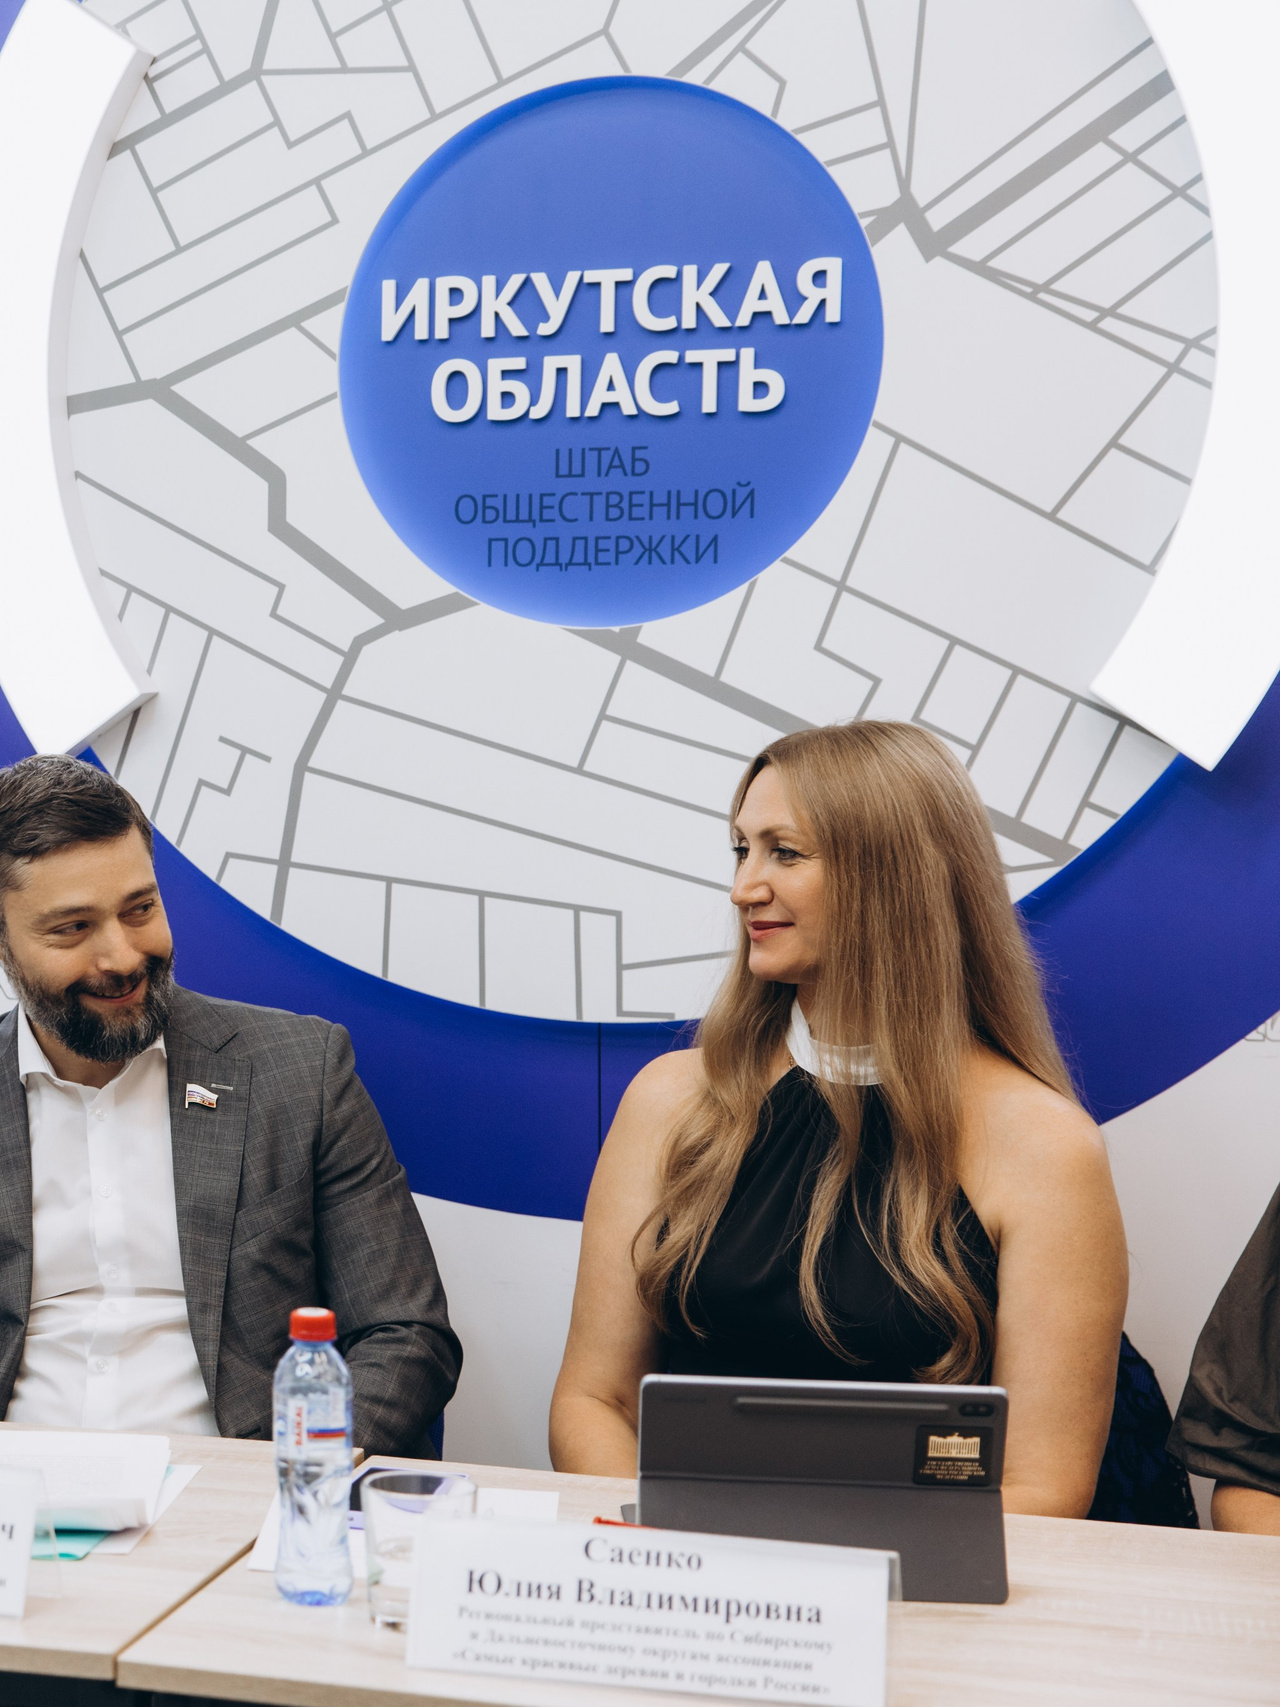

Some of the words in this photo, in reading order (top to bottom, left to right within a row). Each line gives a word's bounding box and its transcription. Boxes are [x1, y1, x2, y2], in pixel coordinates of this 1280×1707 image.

[381, 257, 843, 342] ИРКУТСКАЯ
[431, 347, 786, 423] ОБЛАСТЬ
[555, 446, 650, 478] ШТАБ
[454, 481, 755, 527] ОБЩЕСТВЕННОЙ
[487, 534, 719, 572] ПОДДЕРЖКИ
[584, 1537, 703, 1571] Саенко
[466, 1568, 562, 1602] Юлия
[576, 1578, 823, 1624] Владимировна
